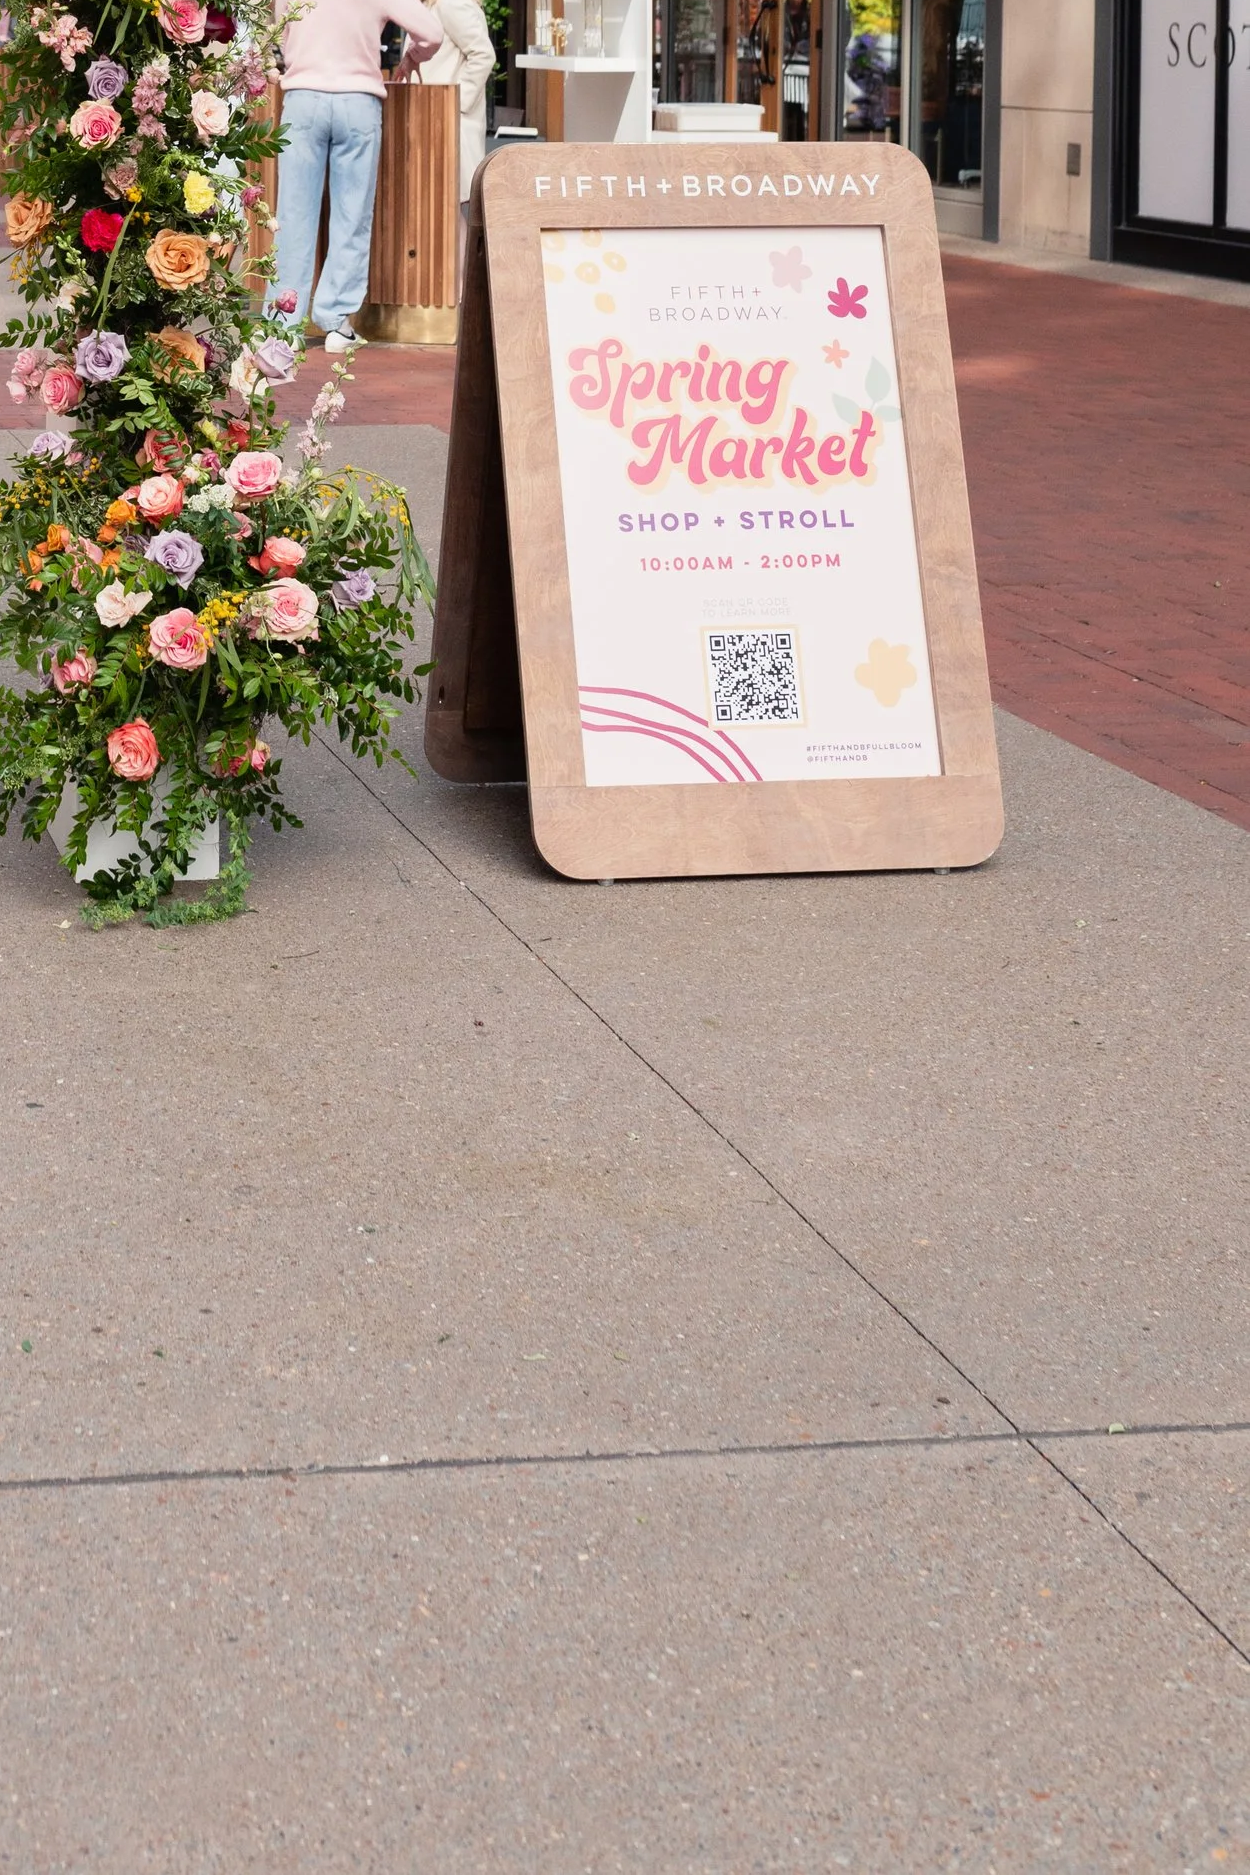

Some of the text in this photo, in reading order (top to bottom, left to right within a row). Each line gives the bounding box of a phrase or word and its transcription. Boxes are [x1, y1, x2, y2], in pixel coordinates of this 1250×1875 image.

[534, 175, 647, 198] FIFTH
[681, 173, 881, 197] BROADWAY
[670, 285, 745, 301] FIFTH
[648, 305, 784, 322] BROADWAY
[567, 338, 791, 429] Spring
[626, 407, 878, 486] Market
[618, 512, 700, 533] SHOP
[739, 509, 855, 530] STROLL
[640, 555, 734, 572] 10:00AM
[760, 553, 842, 570] 2:00PM
